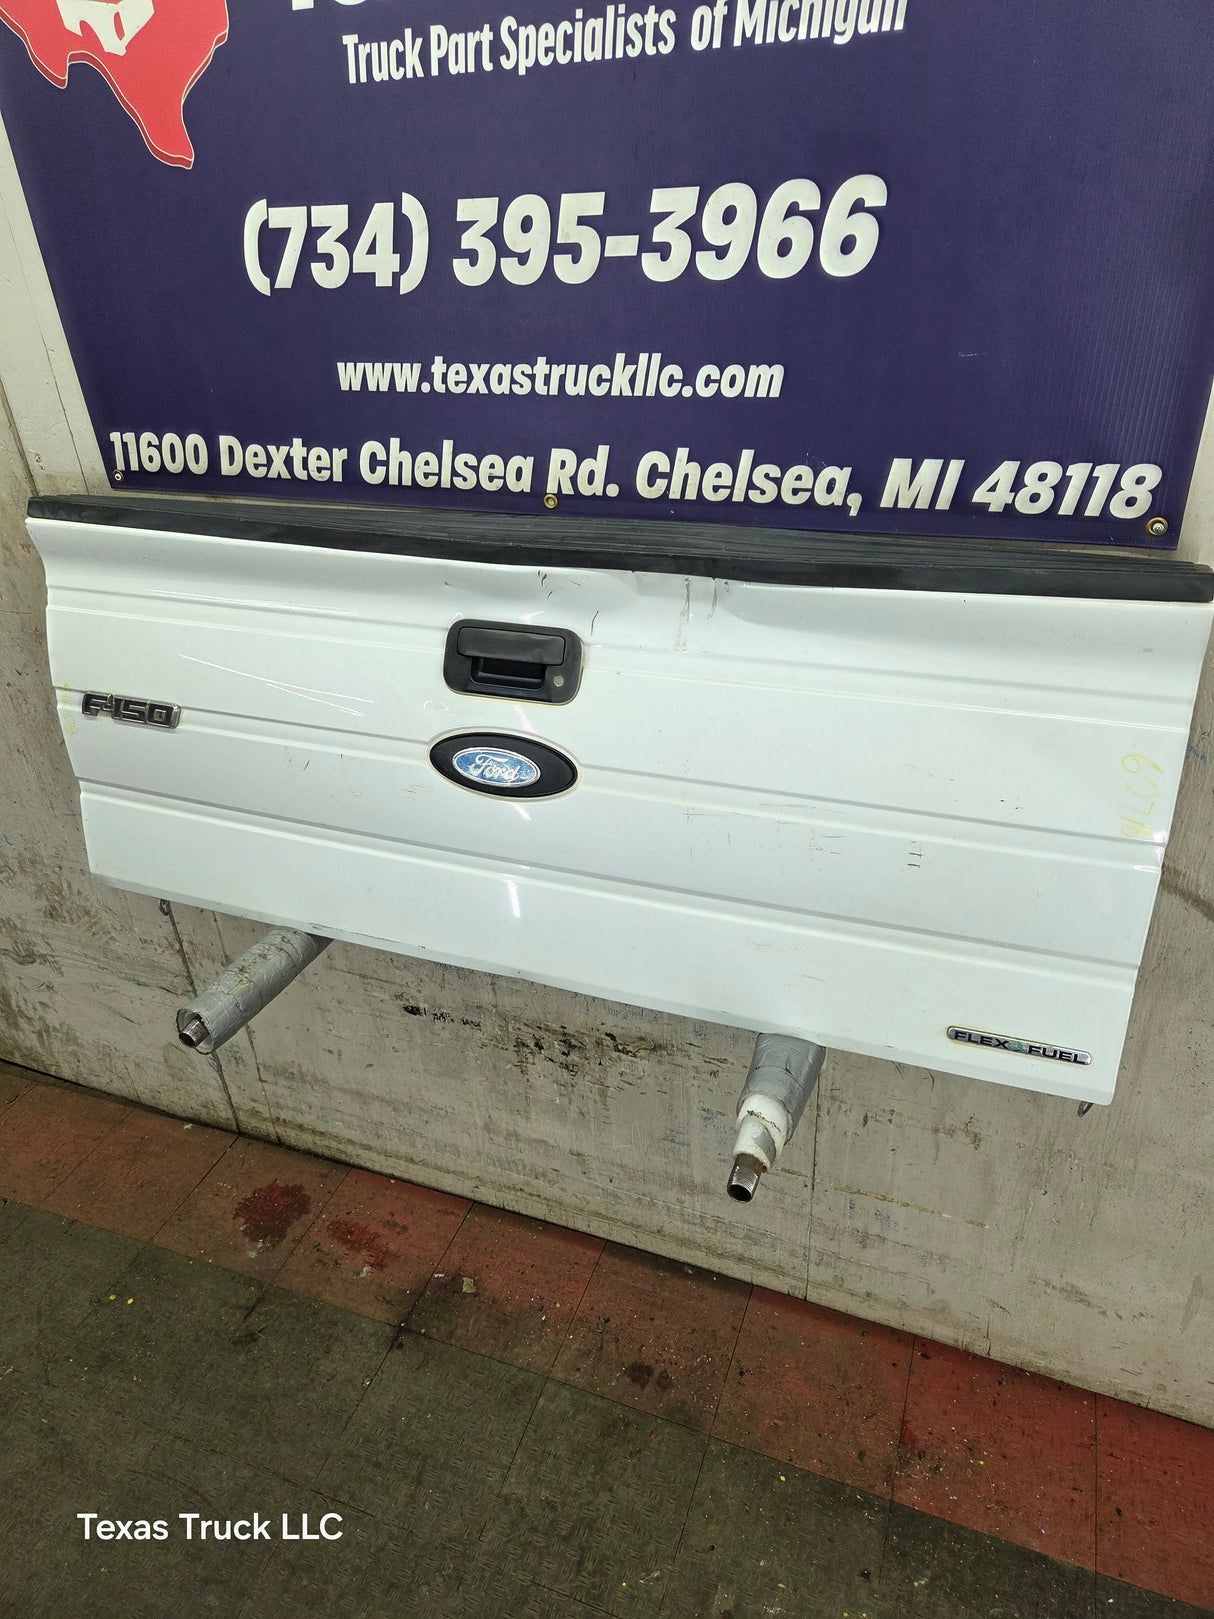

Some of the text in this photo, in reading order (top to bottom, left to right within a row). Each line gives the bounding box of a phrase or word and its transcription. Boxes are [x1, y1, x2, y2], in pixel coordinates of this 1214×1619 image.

[342, 0, 908, 85] Truck Part Specialists of Michigan
[243, 174, 888, 296] (734) 395-3966
[337, 352, 785, 398] www.texastruckllc.com
[109, 431, 1163, 519] 11600 Dexter Chelsea Rd. Chelsea, MI 48118
[82, 690, 181, 729] F-150
[468, 754, 521, 782] Ford
[953, 1030, 1088, 1065] FLEX FUEL
